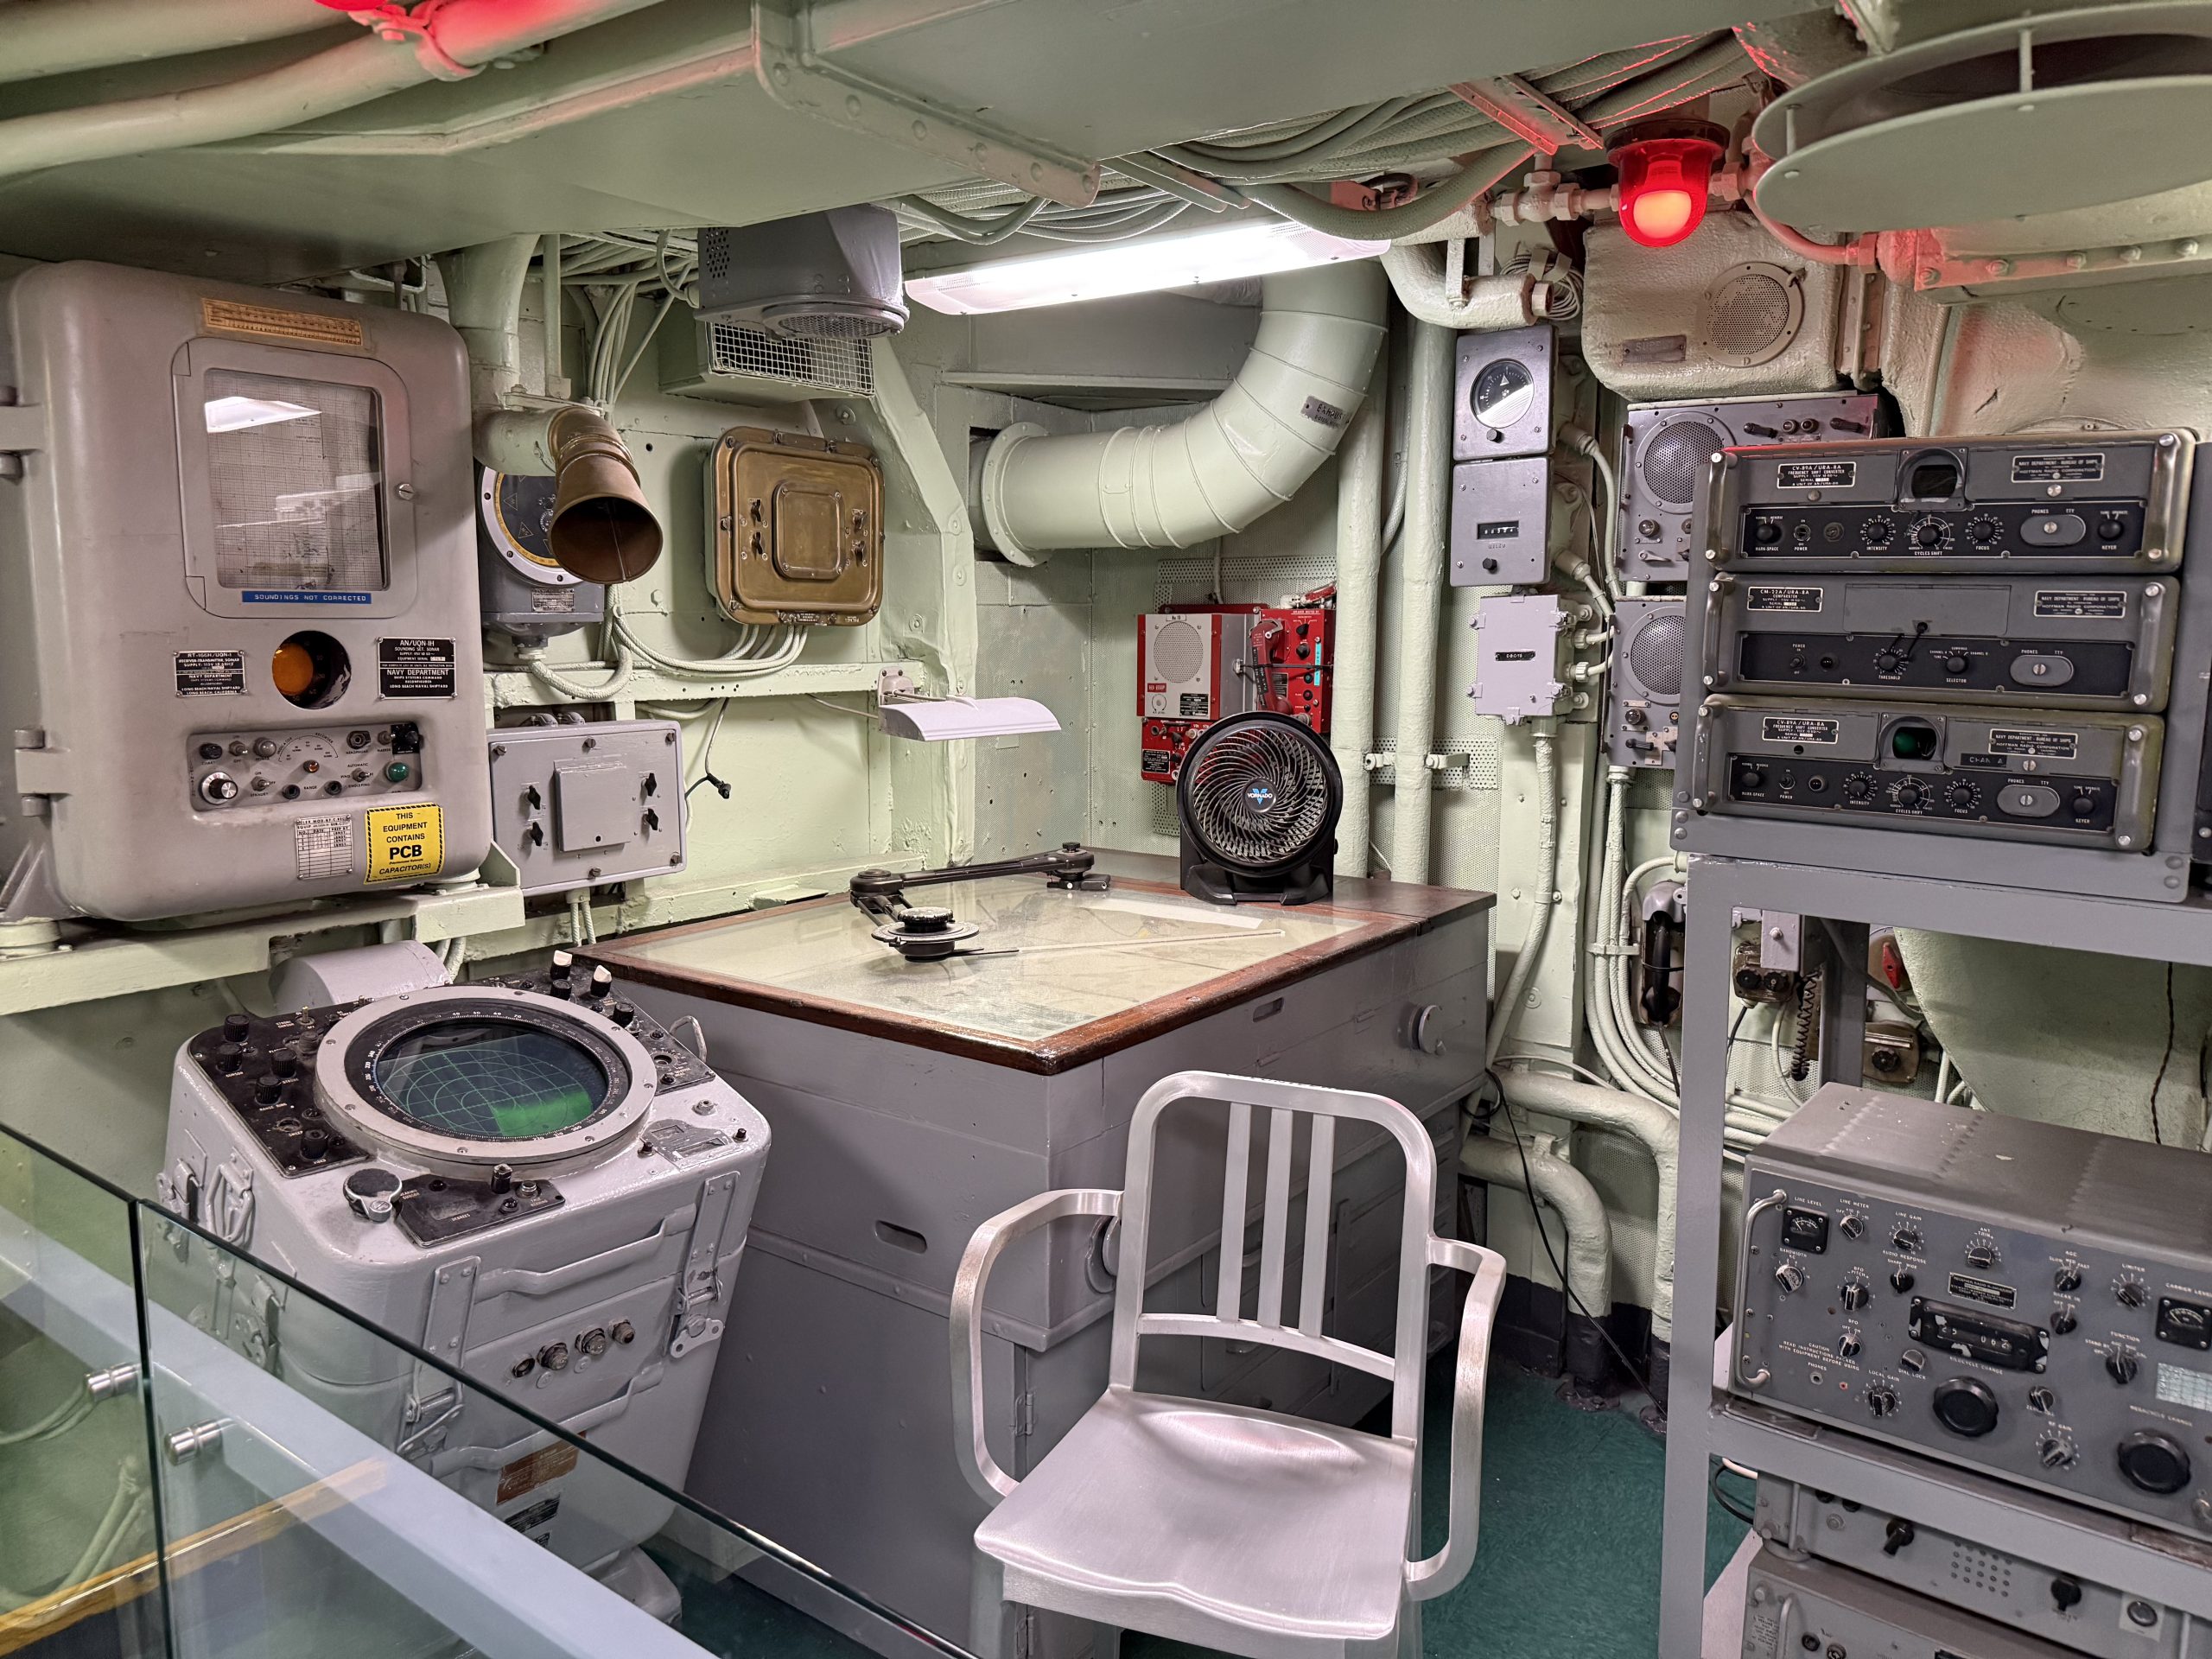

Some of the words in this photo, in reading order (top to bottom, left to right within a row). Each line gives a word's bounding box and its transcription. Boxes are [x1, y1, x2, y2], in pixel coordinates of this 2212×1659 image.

[1317, 404, 1344, 421] EXHAUS
[383, 822, 428, 832] EQUIPMENT
[386, 833, 425, 843] CONTAINS
[389, 844, 423, 860] PCB
[378, 862, 431, 875] CAPACITOR(S)
[451, 1213, 471, 1222] DEGREES
[1779, 1247, 1808, 1258] BANDWIDTH
[1899, 1254, 1927, 1265] RESPONSE
[2121, 1263, 2145, 1272] LIMITER
[2165, 1282, 2192, 1293] CARRIER
[2053, 1291, 2072, 1300] BREAK
[2110, 1331, 2141, 1342] FUNCTION
[1808, 1342, 1830, 1351] CAUTION
[2084, 1338, 2102, 1347] STAND
[1793, 1348, 1821, 1360] EQUIPMENT
[1822, 1357, 1842, 1365] BEFORE
[1844, 1363, 1859, 1371] USING
[1798, 1344, 1834, 1358] INSTRUCTIONS
[1835, 1355, 1856, 1365] PACKED
[1808, 1361, 1827, 1371] PHONES
[1949, 1356, 1980, 1370] KILOCYCLE
[1980, 1363, 2004, 1375] CHANGE
[1868, 1369, 1885, 1379] LOCAL
[1910, 1371, 1927, 1380] LOCK
[2167, 1415, 2193, 1427] CHANGE
